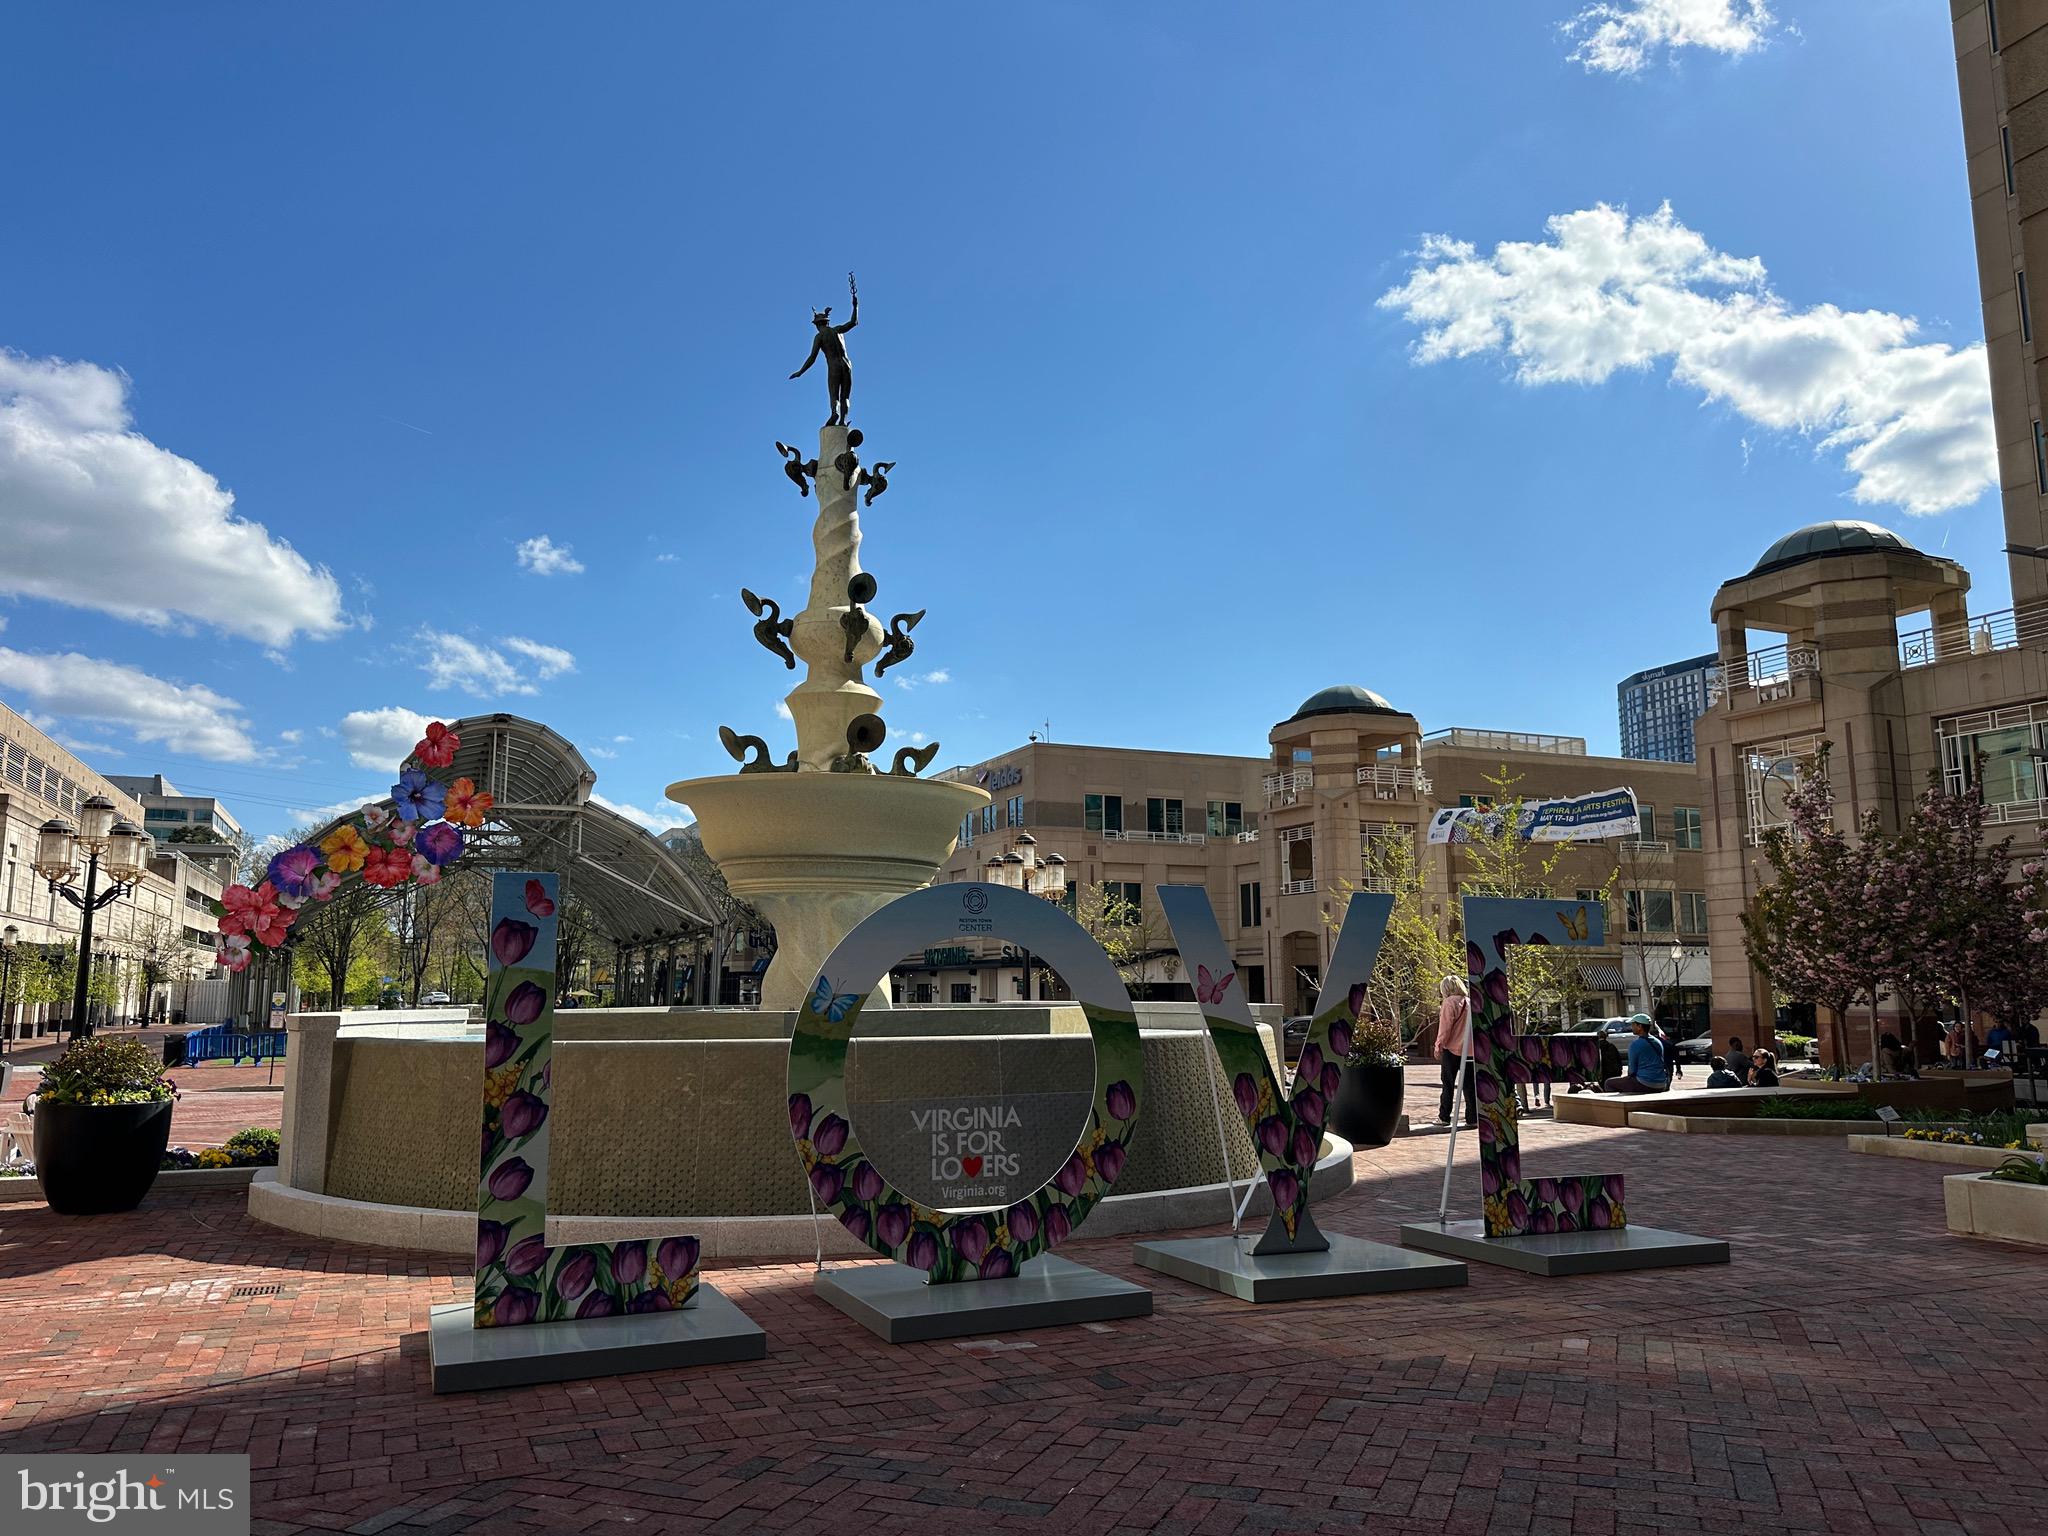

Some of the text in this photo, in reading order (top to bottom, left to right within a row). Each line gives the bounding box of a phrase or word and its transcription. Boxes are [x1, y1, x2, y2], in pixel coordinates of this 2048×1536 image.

[1641, 667, 1666, 681] skymark
[988, 768, 1022, 791] leidos
[1541, 807, 1570, 815] TEPHRA
[1582, 803, 1601, 812] ARTS
[1540, 814, 1554, 822] MAY
[959, 923, 993, 932] CENTER
[910, 1105, 1022, 1132] VIRGINIA
[932, 1130, 1007, 1156] IS FOR
[942, 1184, 1006, 1200] Virginia.org
